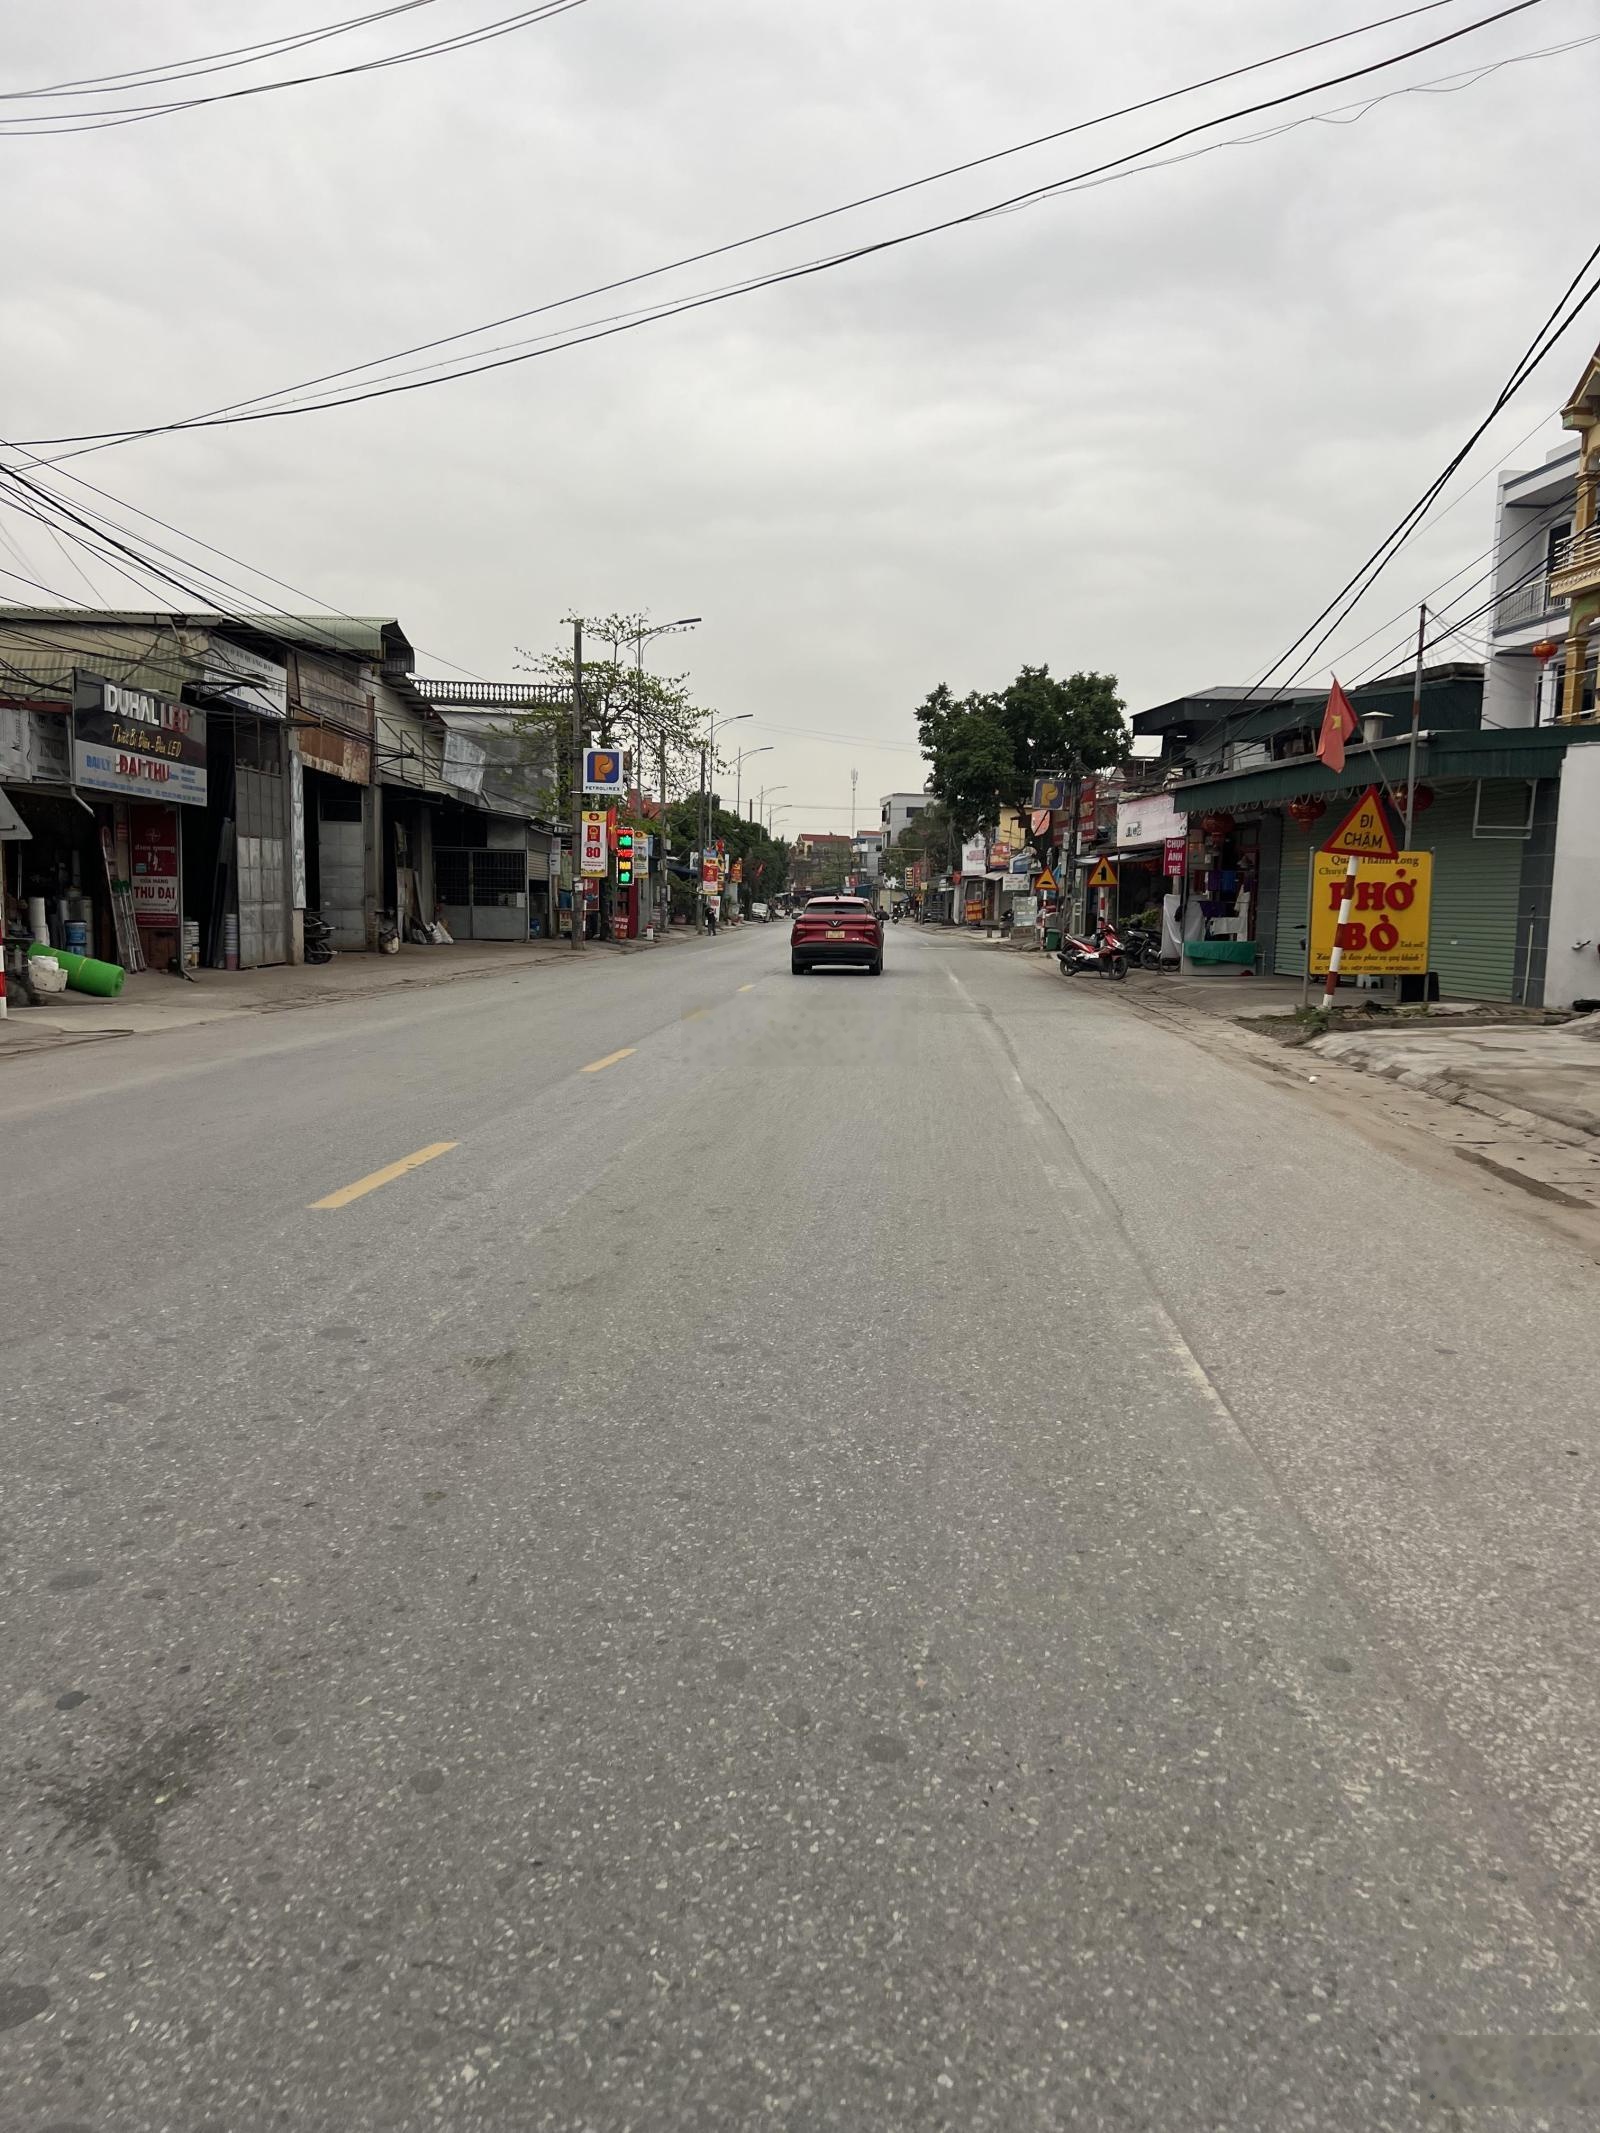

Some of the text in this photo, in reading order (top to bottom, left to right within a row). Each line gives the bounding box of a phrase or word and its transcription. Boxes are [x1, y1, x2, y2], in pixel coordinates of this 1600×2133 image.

[104, 684, 159, 725] DUHAL
[1360, 814, 1373, 828] ĐI
[1166, 839, 1185, 850] CHỤP
[1344, 831, 1384, 849] CHẬM
[586, 846, 601, 858] 80
[1168, 850, 1182, 861] ẢNH
[1331, 855, 1349, 865] Qu
[1319, 867, 1347, 877] Chuyê
[134, 886, 175, 903] THU ĐẠI
[1328, 868, 1417, 911] PHỞ
[1340, 914, 1399, 952] BÒ
